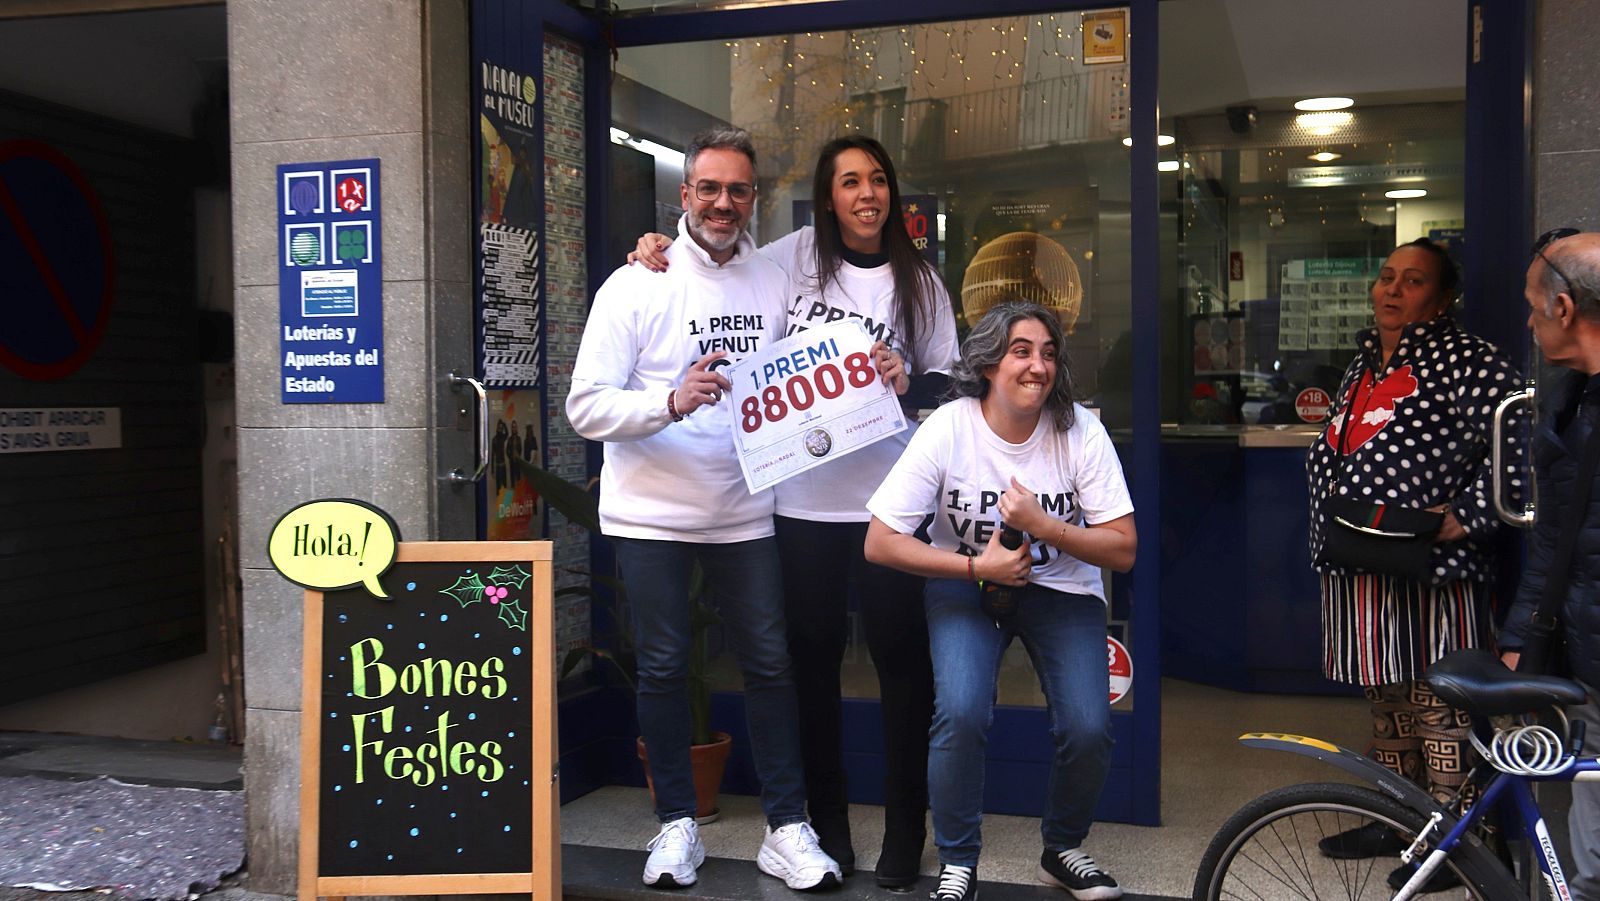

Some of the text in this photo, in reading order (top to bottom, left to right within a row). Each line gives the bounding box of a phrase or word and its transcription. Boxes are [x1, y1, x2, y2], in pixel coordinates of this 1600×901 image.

[482, 61, 524, 100] NADAL
[484, 94, 534, 128] AL MUSEU
[284, 323, 356, 344] Loterías y
[710, 316, 764, 336] PREMI
[698, 336, 760, 356] VENUT
[284, 349, 378, 370] Apuestas del
[764, 338, 840, 385] PREMI
[286, 376, 335, 392] Estado
[741, 352, 876, 433] 88008
[50, 410, 106, 426] APARCAR
[57, 432, 91, 446] GRUA
[980, 490, 1076, 516] PMI
[292, 520, 372, 567] Hola!
[350, 637, 508, 700] Bones
[350, 705, 504, 788] Festes
